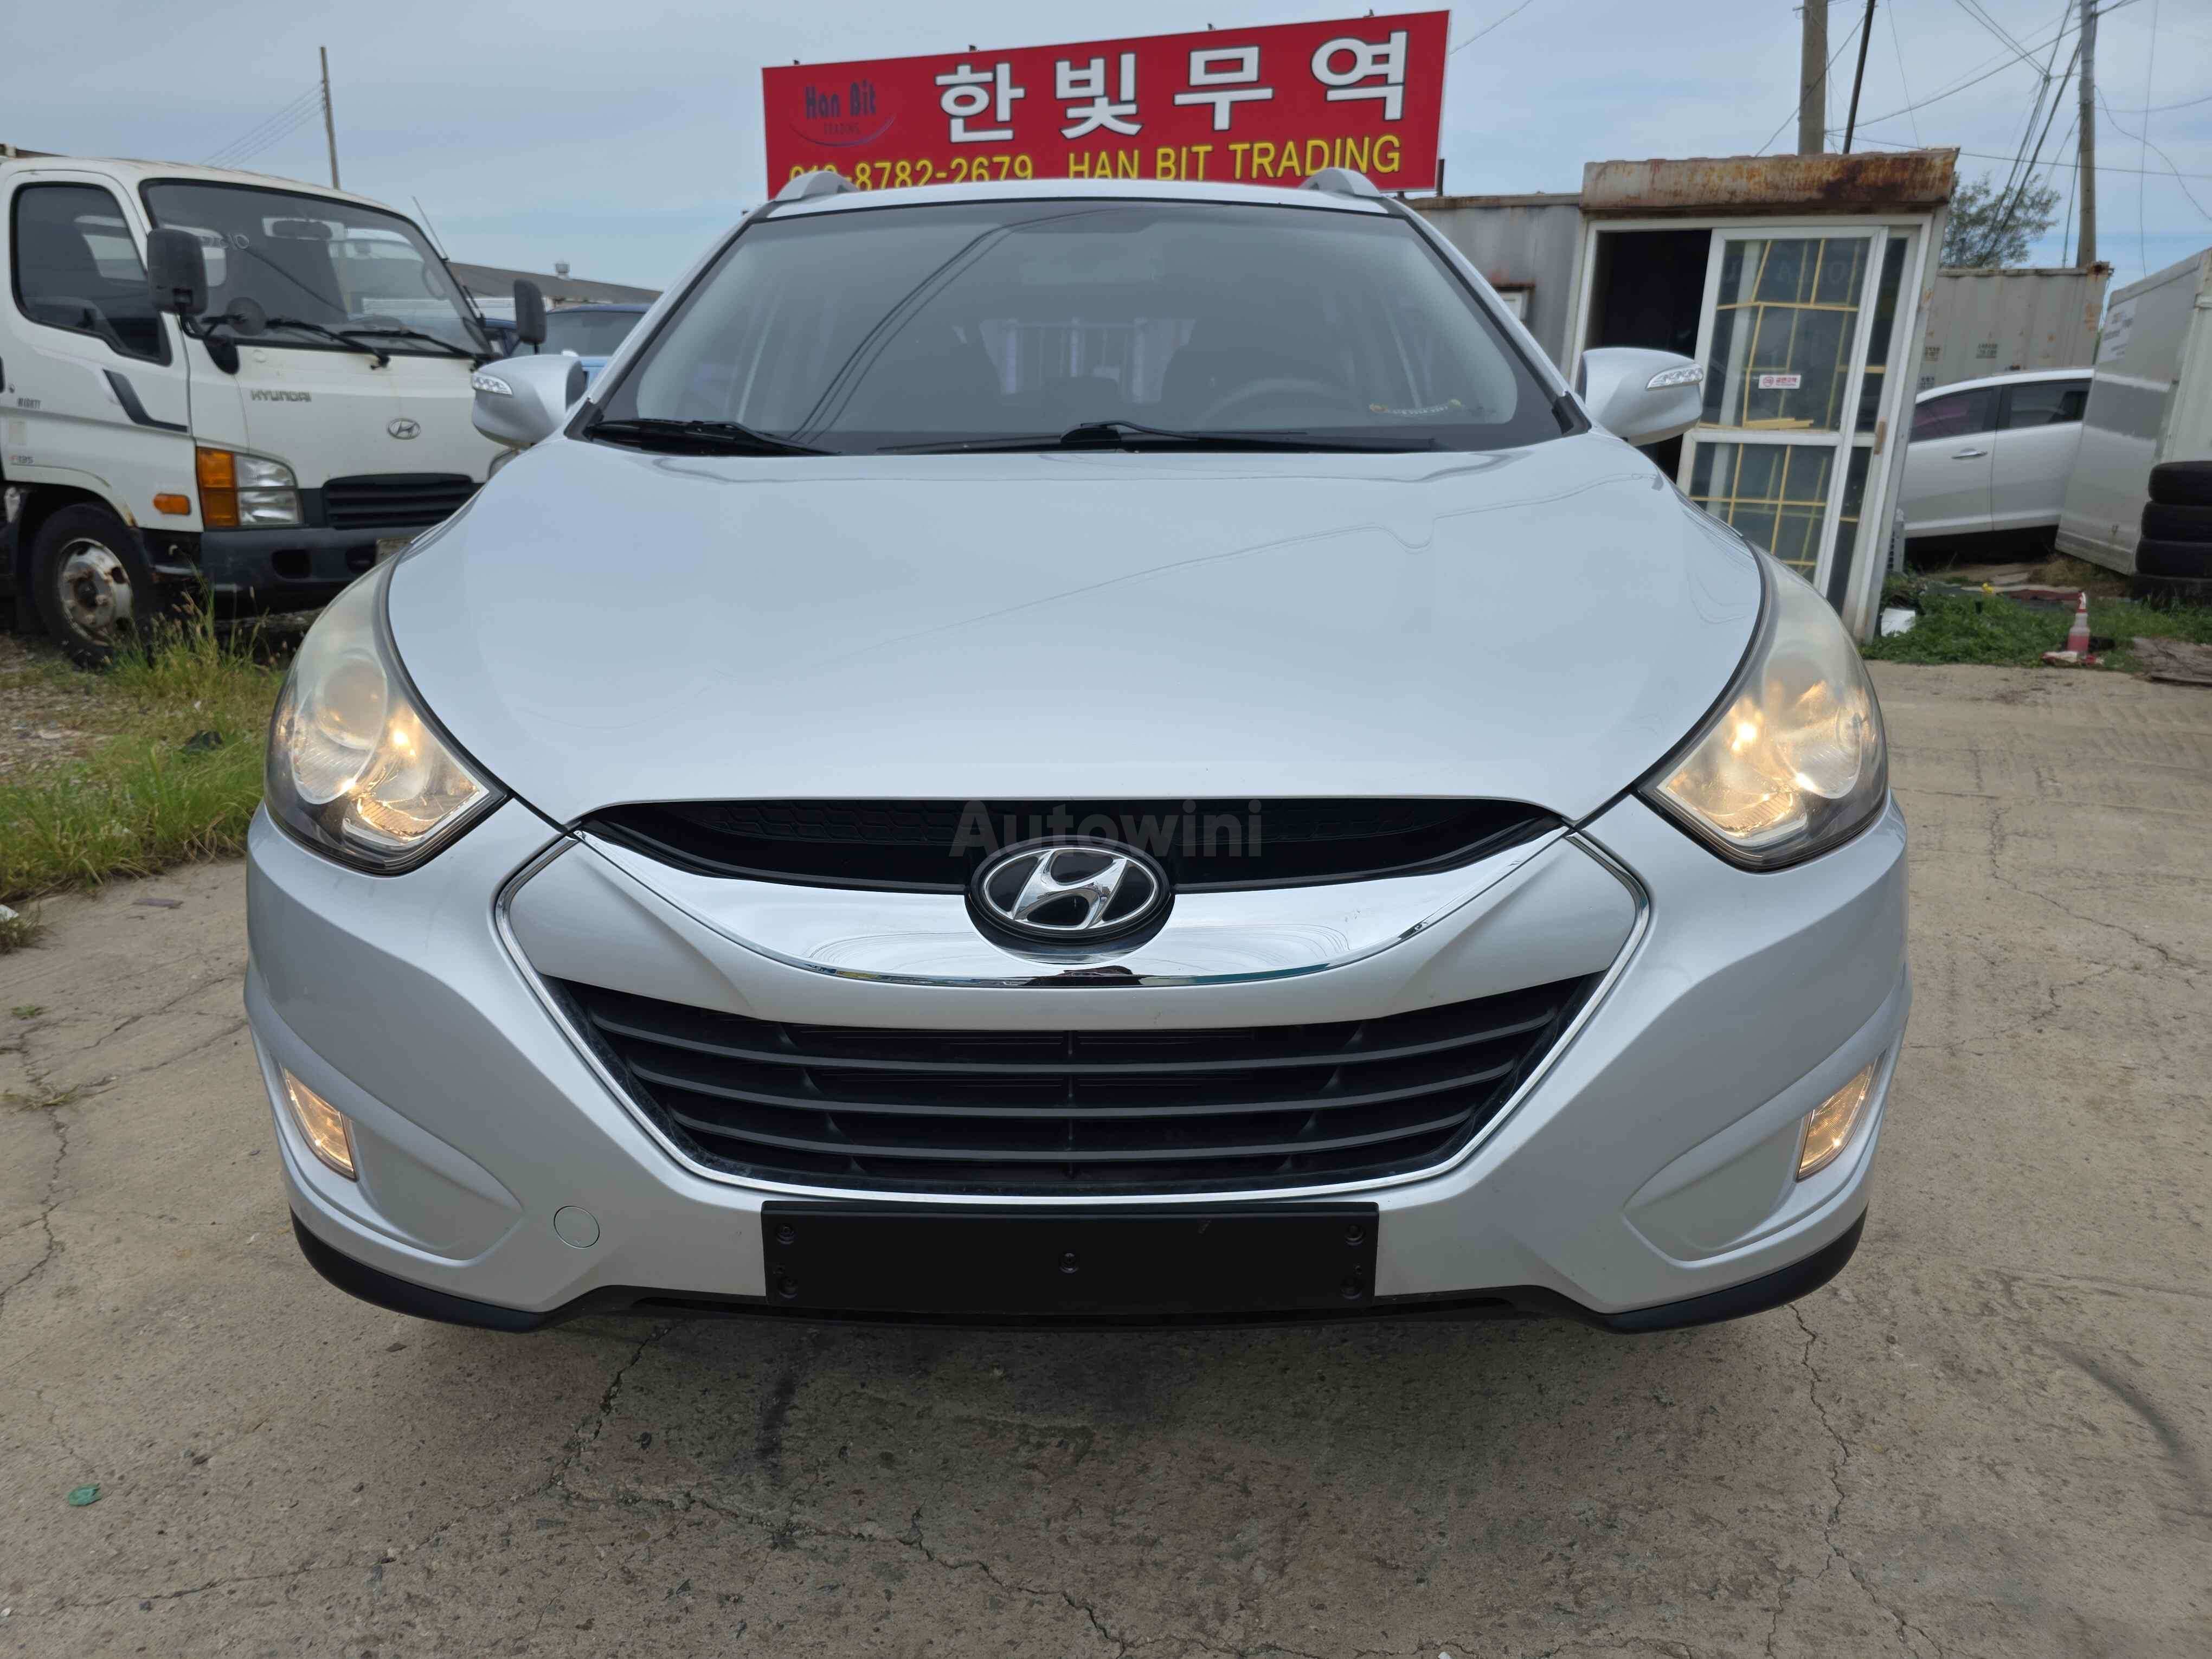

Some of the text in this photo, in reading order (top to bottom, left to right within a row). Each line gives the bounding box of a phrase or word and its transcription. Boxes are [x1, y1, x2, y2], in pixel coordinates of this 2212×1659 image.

[805, 78, 876, 119] Han Bit
[935, 30, 1409, 144] 한빛무역
[789, 135, 1401, 191] -8782-2679 HAN BIT TRADING
[250, 389, 312, 402] HYUNDAI
